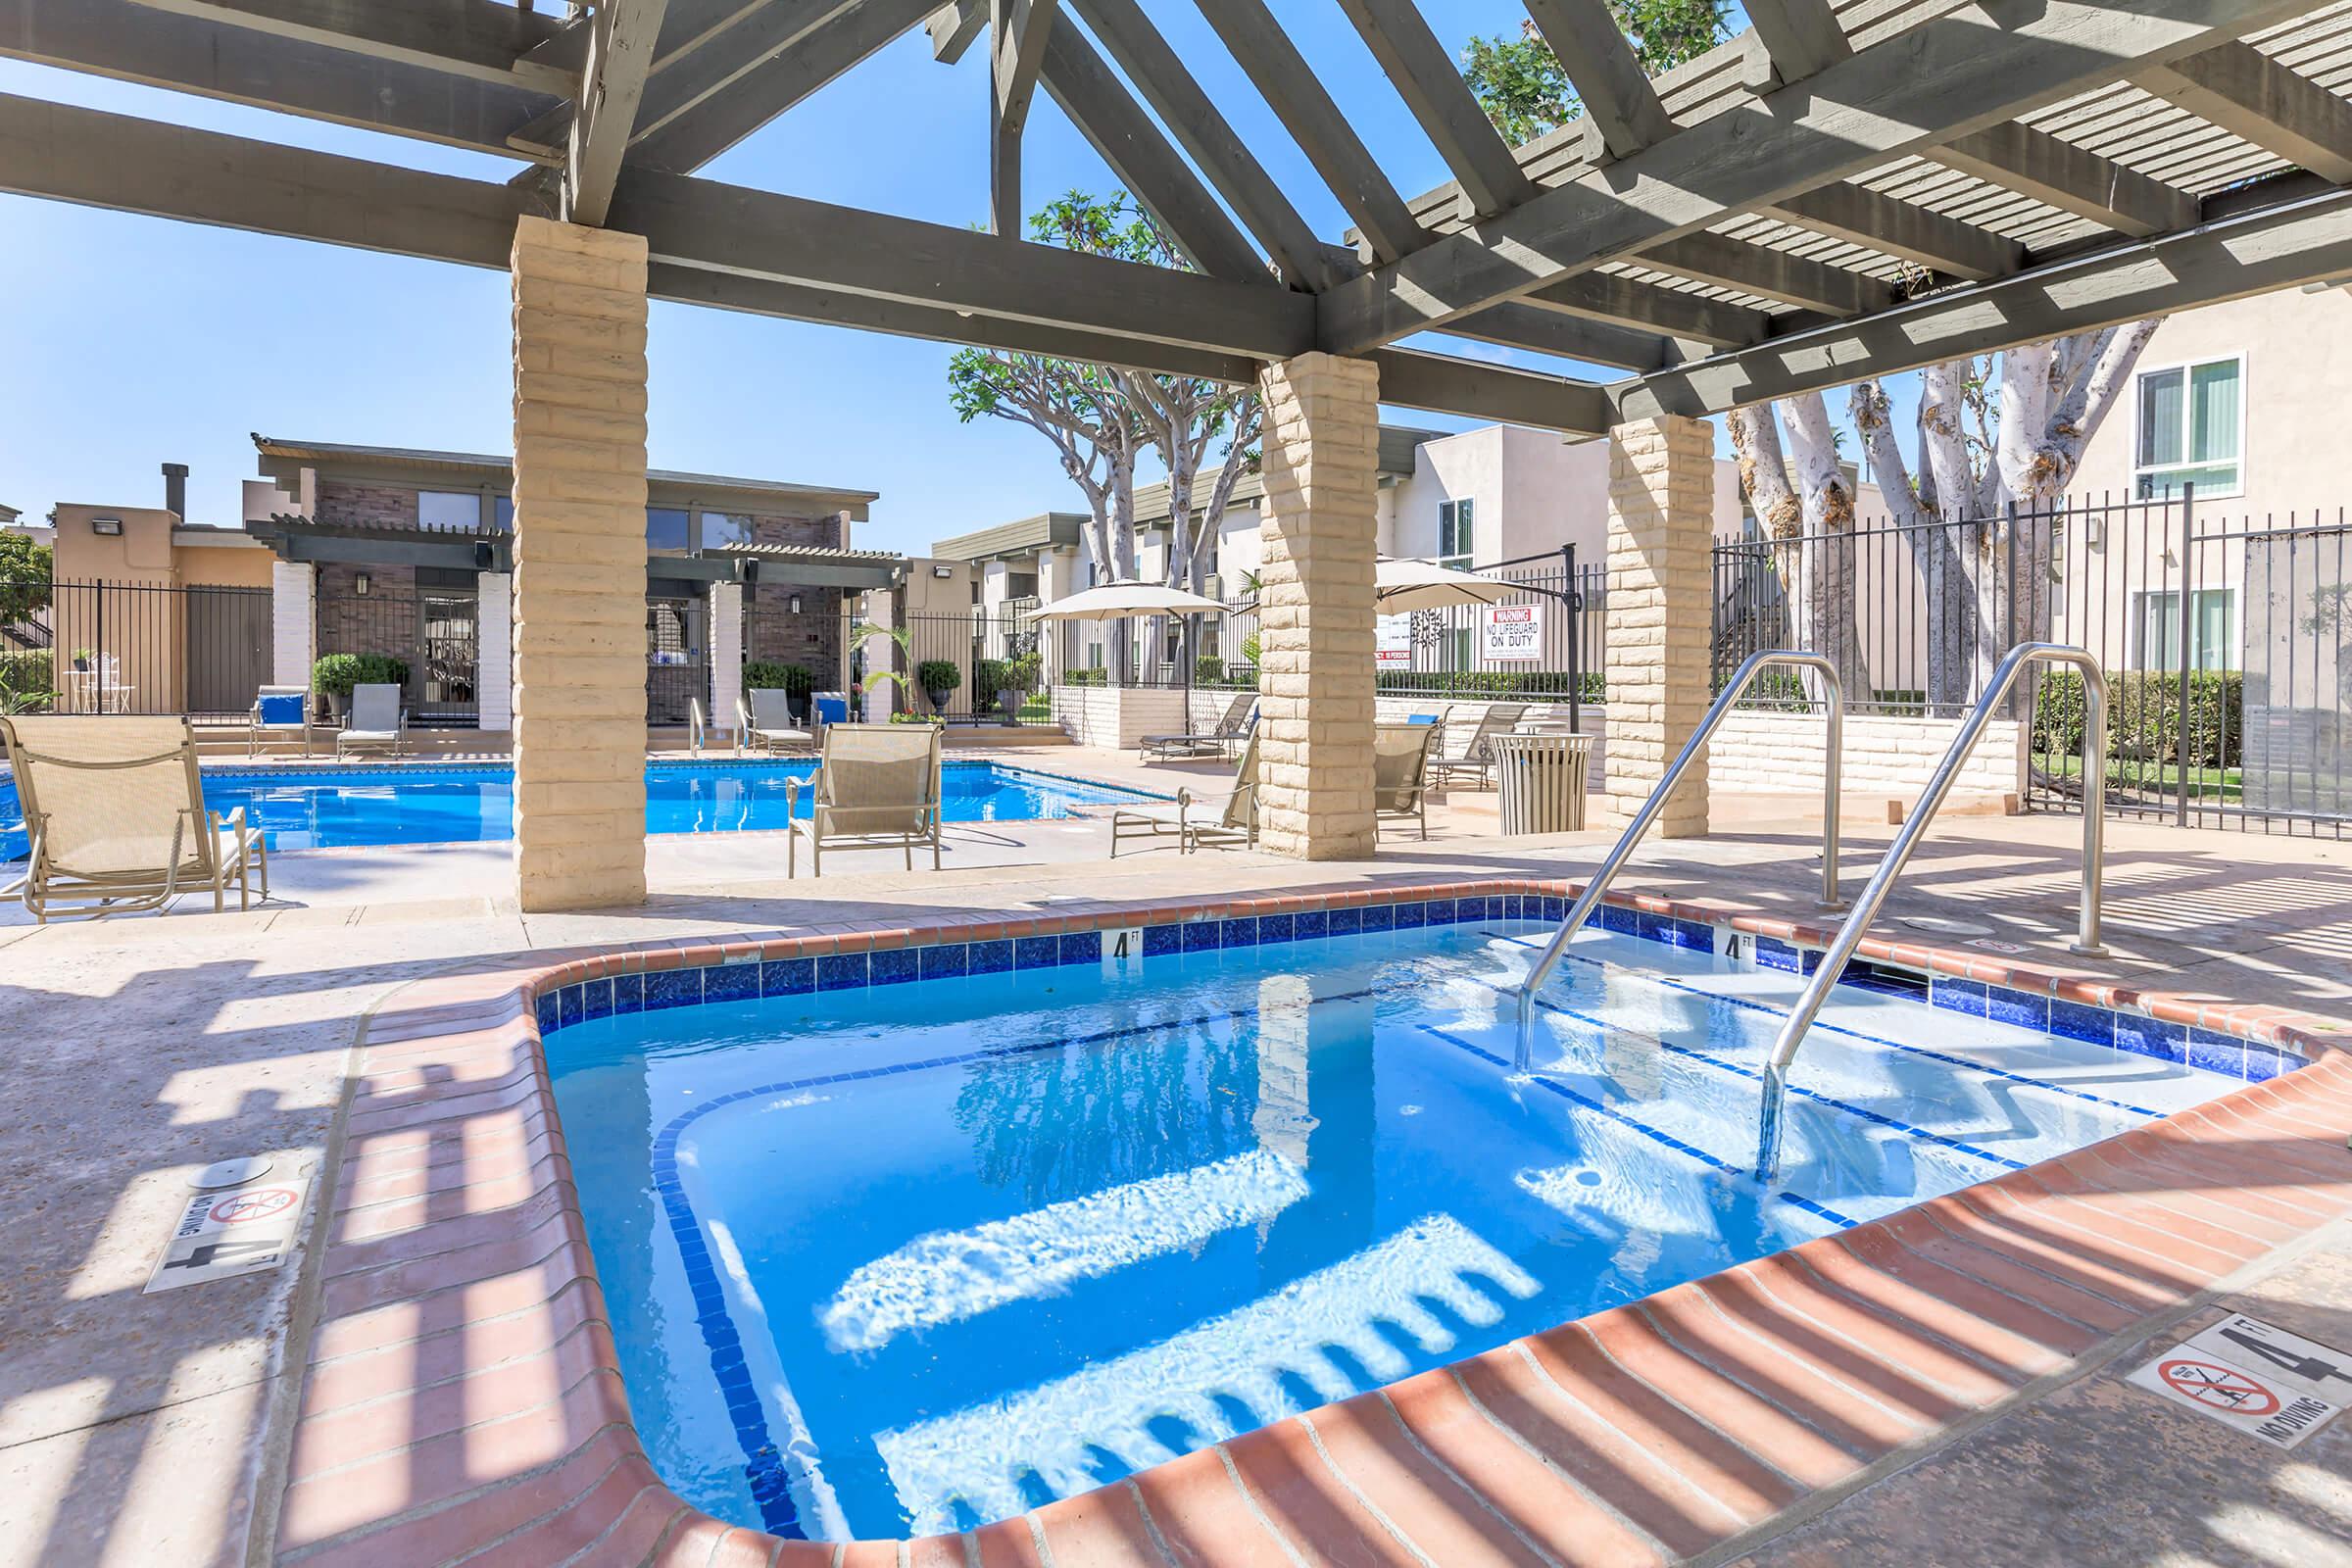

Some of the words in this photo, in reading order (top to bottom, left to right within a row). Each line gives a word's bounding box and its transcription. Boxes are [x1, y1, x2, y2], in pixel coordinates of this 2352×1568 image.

[1496, 610, 1529, 621] WARNING
[1487, 624, 1496, 635] NO
[1499, 622, 1538, 635] LIFEGUARD
[1491, 636, 1503, 647] ON
[1508, 635, 1533, 647] DUTY
[1113, 932, 1130, 958] 4
[1131, 931, 1140, 942] FT
[1725, 934, 1740, 959] 4
[1742, 936, 1751, 947] FT
[192, 1195, 217, 1207] NO
[178, 1207, 210, 1236] DIVING
[163, 1239, 283, 1270] 4
[2233, 1319, 2273, 1337] FT
[2218, 1327, 2352, 1384] 4
[2273, 1396, 2329, 1430] DIVING
[2256, 1422, 2294, 1443] NO
